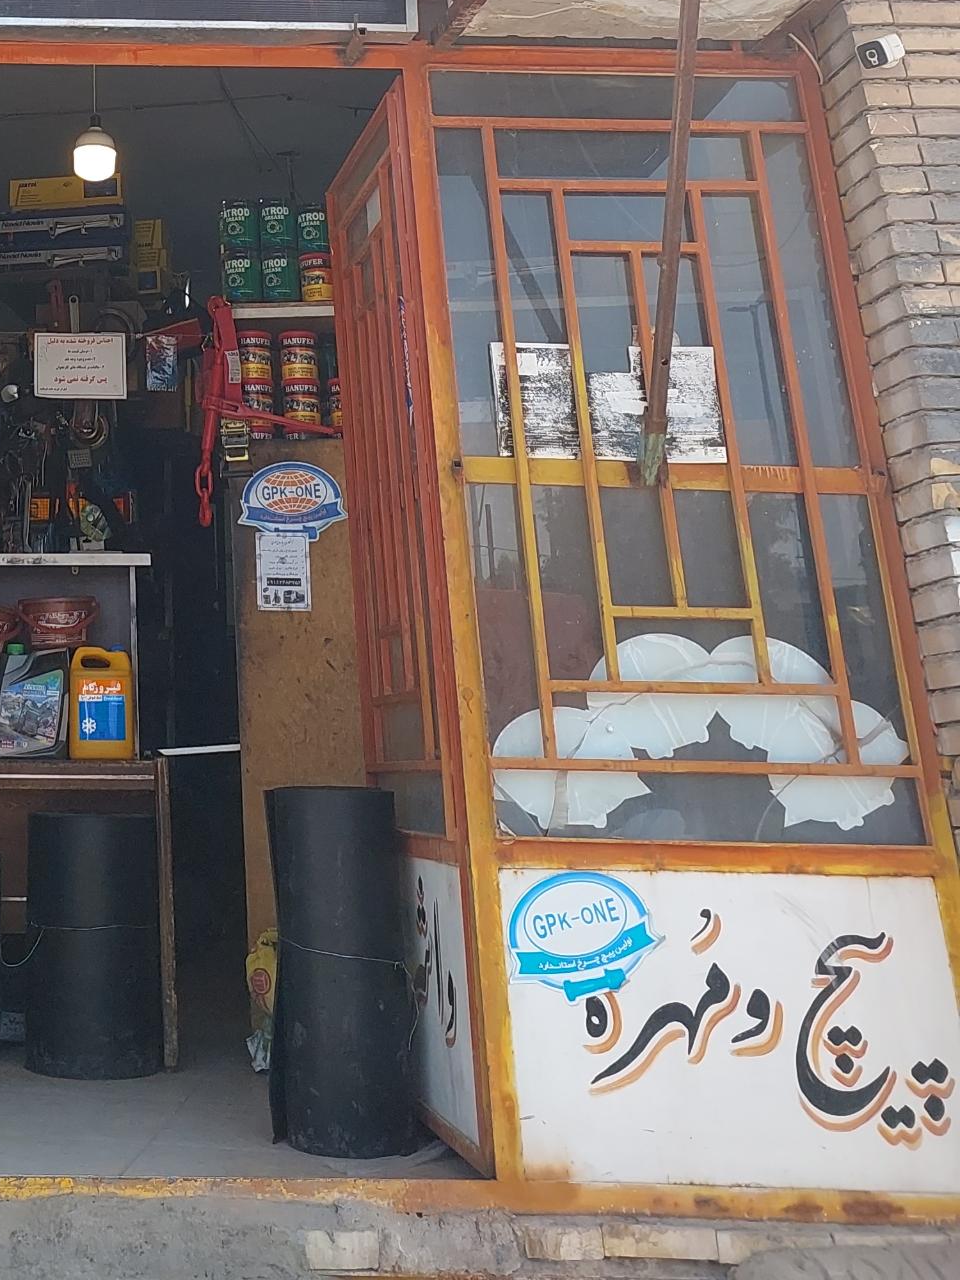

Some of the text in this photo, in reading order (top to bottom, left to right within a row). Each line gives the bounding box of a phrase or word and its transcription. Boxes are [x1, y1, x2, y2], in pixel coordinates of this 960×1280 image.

[262, 483, 322, 501] GPK-ONE
[532, 897, 620, 939] GPK-ONE
[795, 930, 956, 1150] پیچ
